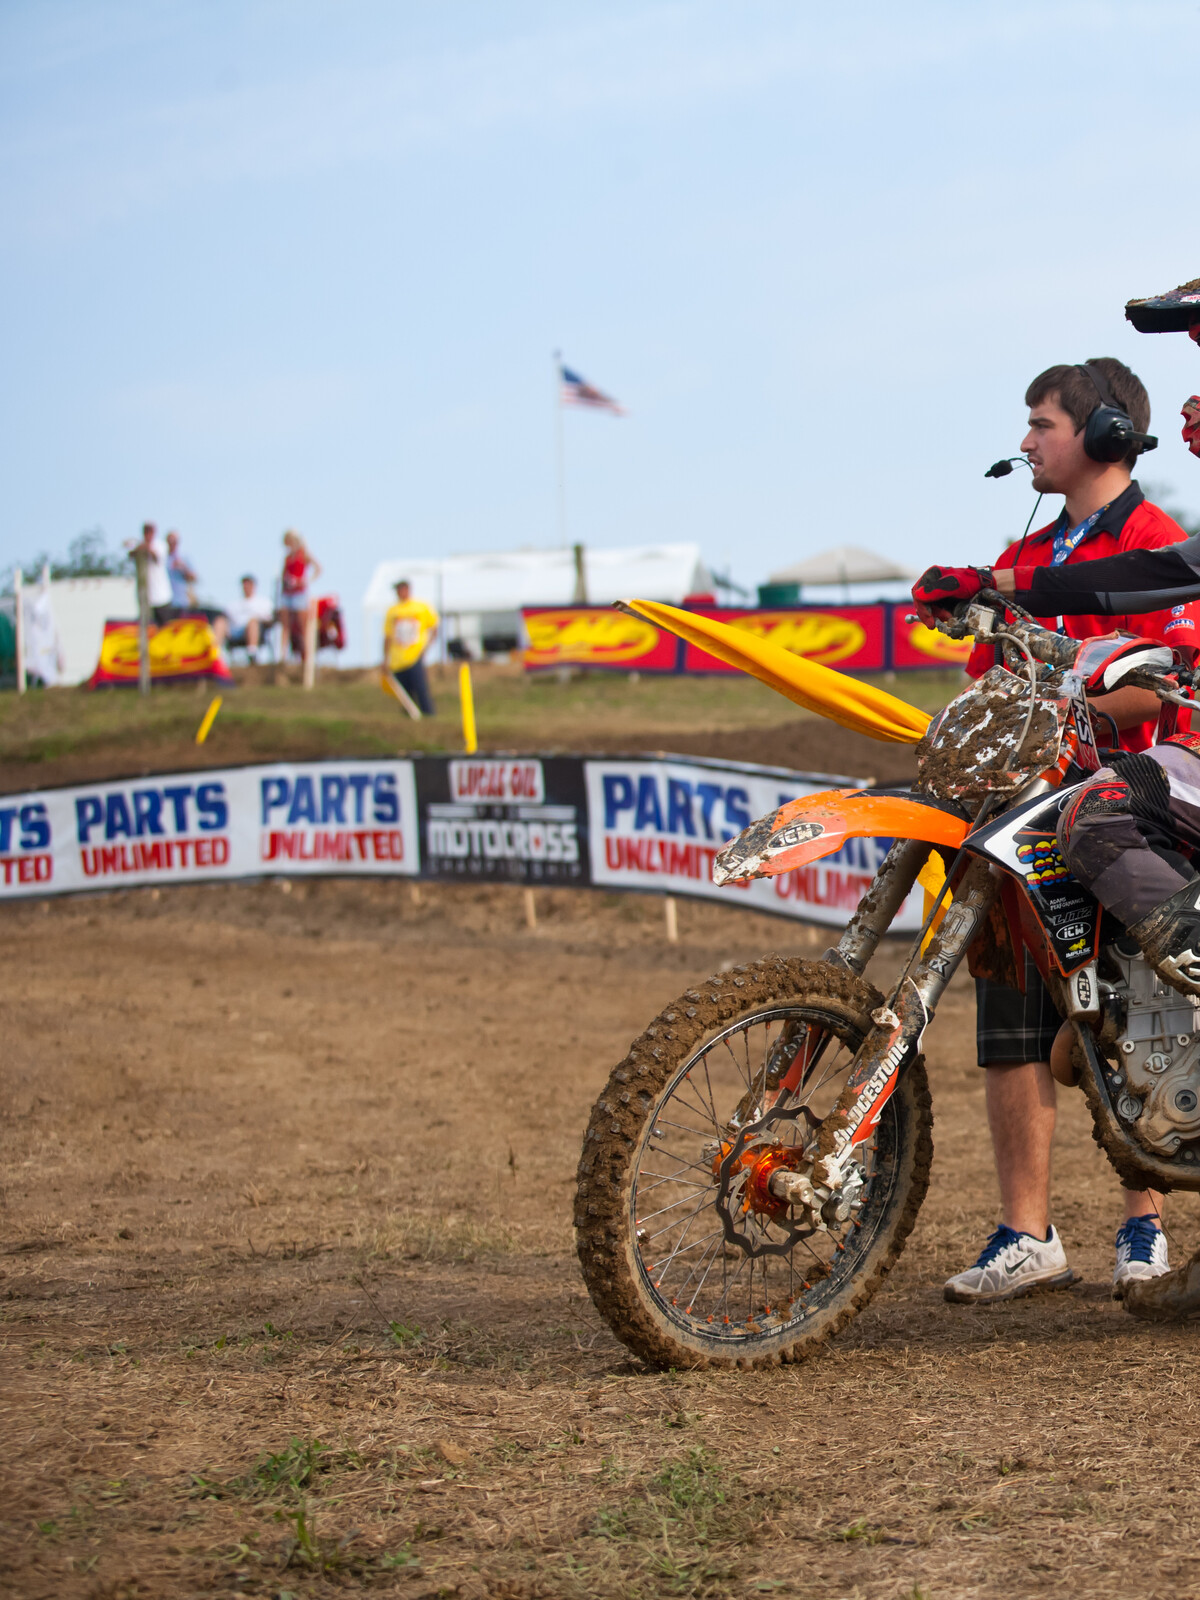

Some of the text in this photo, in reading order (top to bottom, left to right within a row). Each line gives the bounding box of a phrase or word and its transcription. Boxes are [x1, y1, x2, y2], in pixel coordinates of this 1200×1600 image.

[261, 773, 400, 826] PARTS
[458, 767, 537, 797] LUCAS OIL
[75, 781, 228, 843] PARTS
[603, 774, 751, 844] PARTS
[82, 836, 229, 878] UNLIMITED
[261, 829, 402, 862] UNLIMITED
[428, 820, 579, 862] MOTOCROSS
[1066, 947, 1091, 958] IMPULSE
